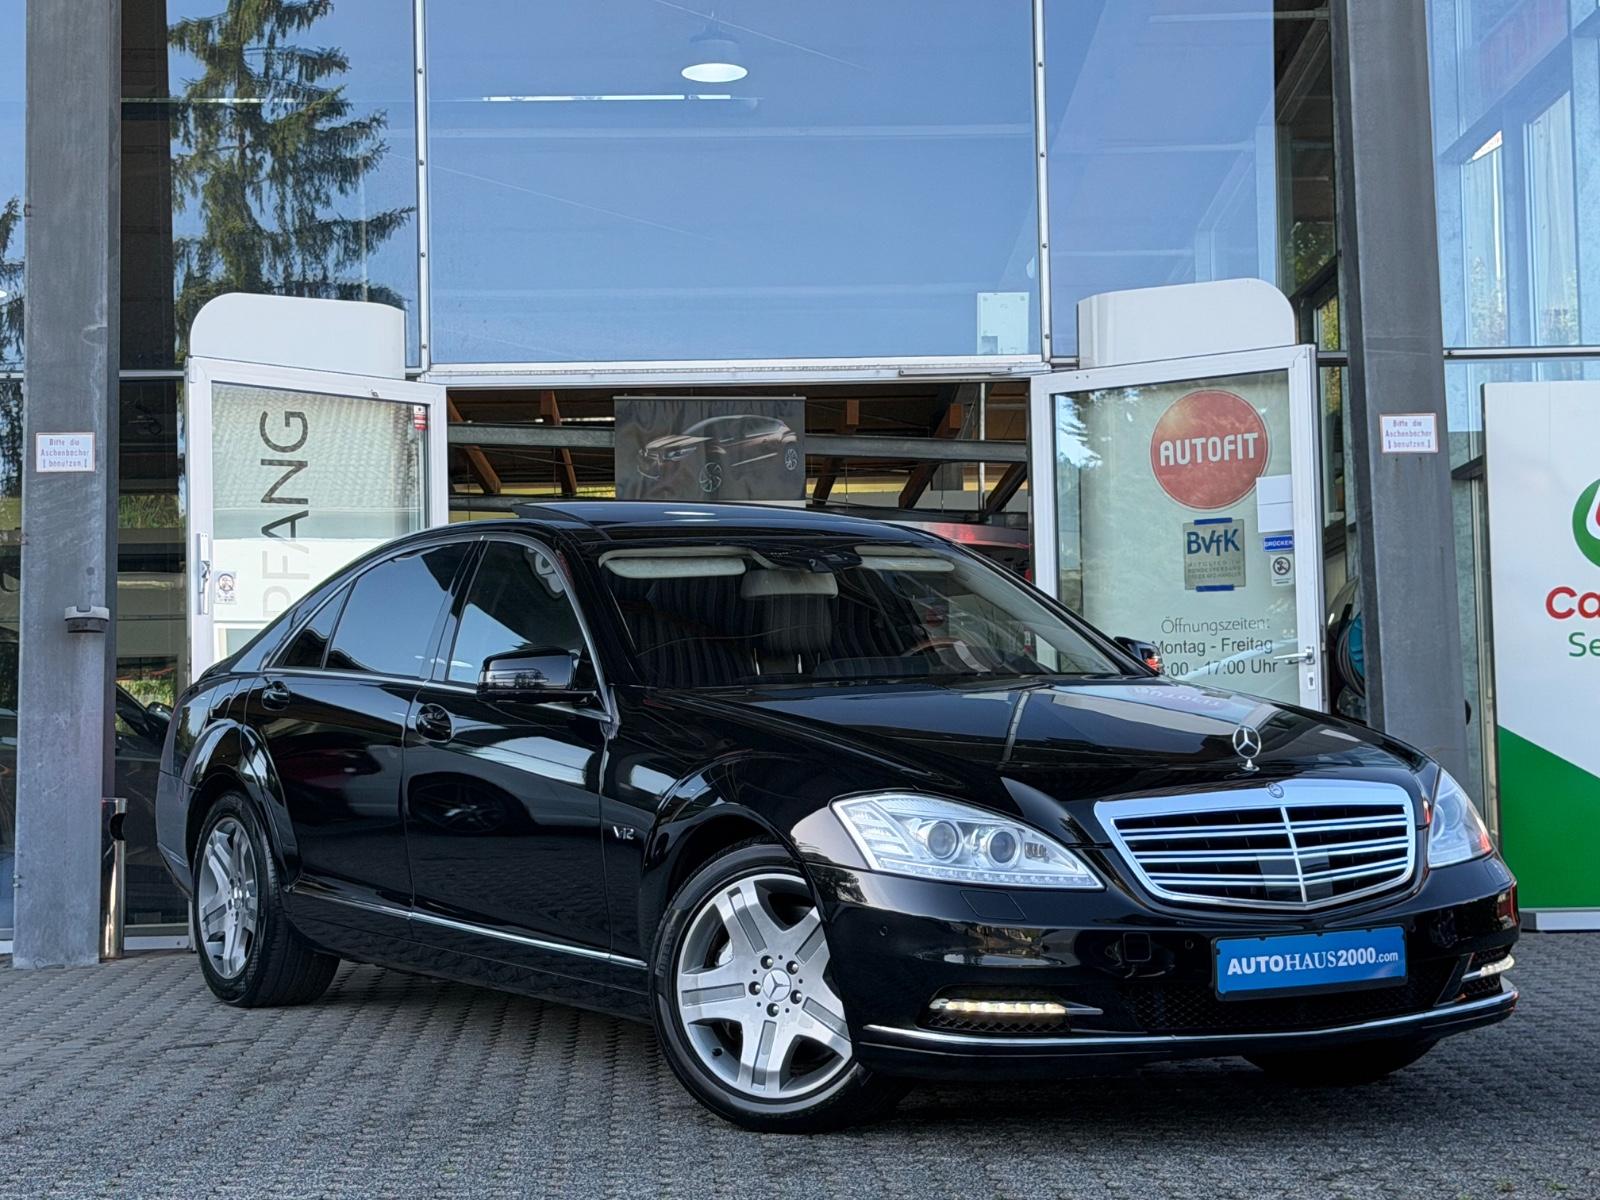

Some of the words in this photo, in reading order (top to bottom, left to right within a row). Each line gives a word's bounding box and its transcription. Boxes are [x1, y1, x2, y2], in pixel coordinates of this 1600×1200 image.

[1160, 432, 1258, 467] AUTOFIT
[1546, 586, 1600, 620] Ca
[1161, 616, 1271, 636] Öffnungszeiten:
[1221, 637, 1274, 654] Freitag
[1205, 659, 1246, 675] 17:00
[1250, 659, 1279, 674] Uhr
[1227, 947, 1399, 976] AUTOHAUS2000.com
